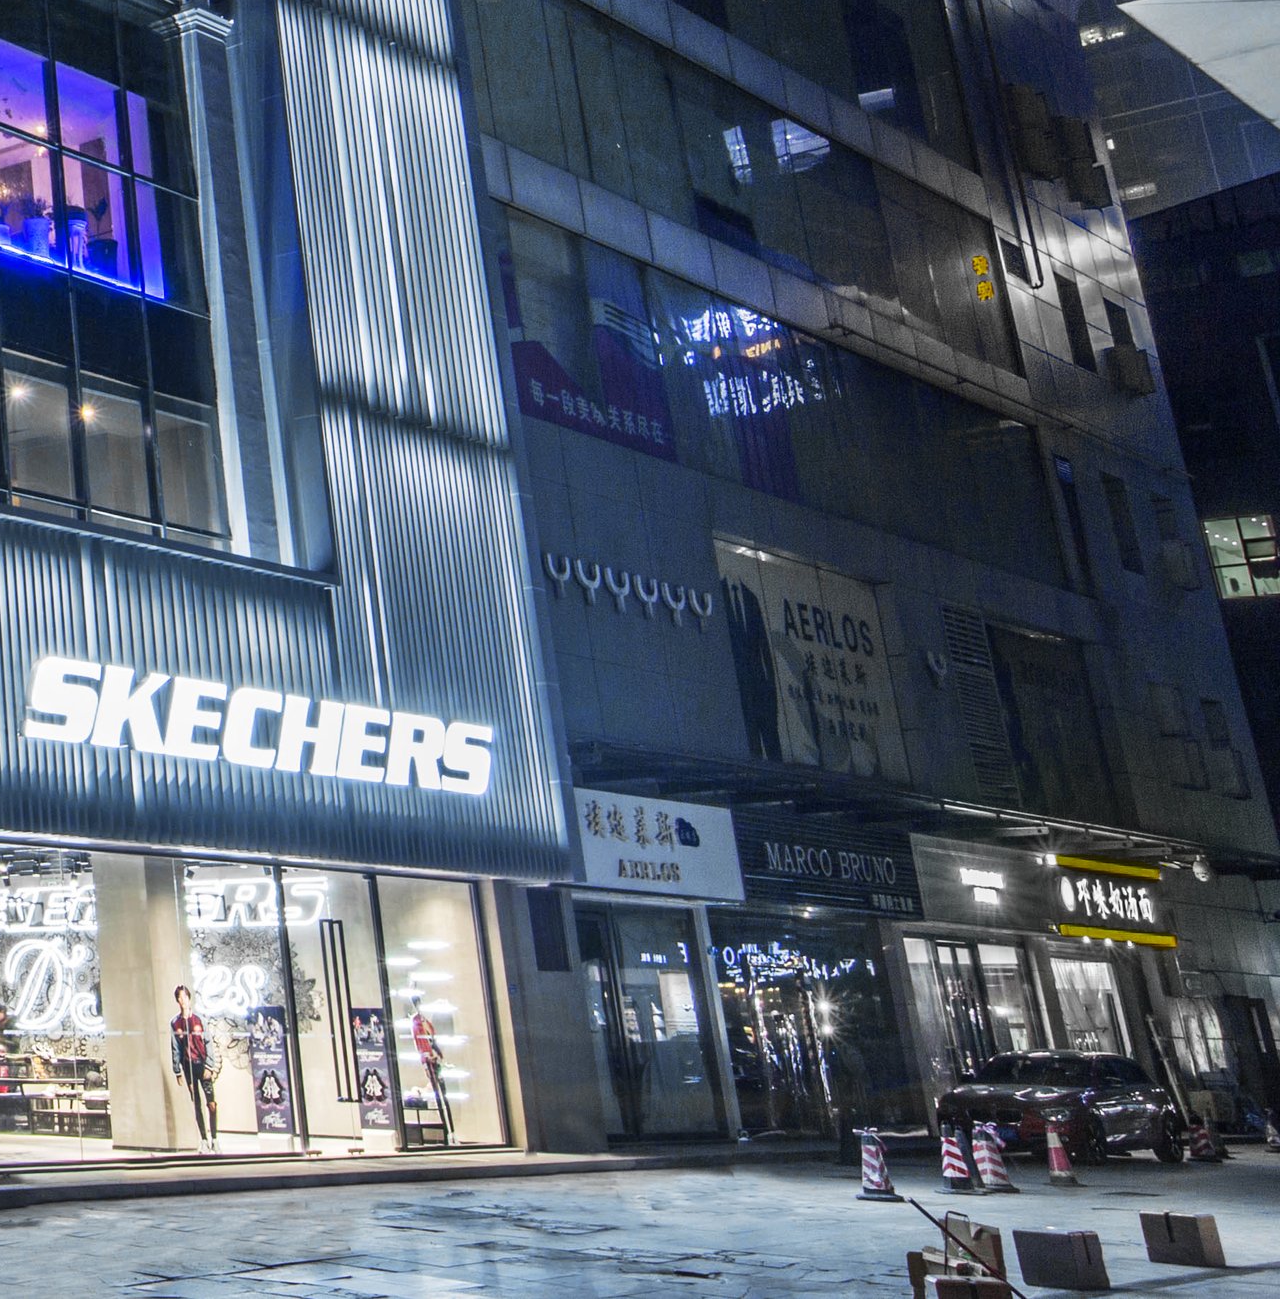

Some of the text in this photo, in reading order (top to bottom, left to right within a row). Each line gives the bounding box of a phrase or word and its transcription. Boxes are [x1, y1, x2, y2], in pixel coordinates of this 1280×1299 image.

[783, 598, 874, 657] AERLOS
[24, 655, 494, 795] SKECHERS
[618, 859, 681, 883] AERLOS
[764, 842, 896, 885] MARCO BRUNO
